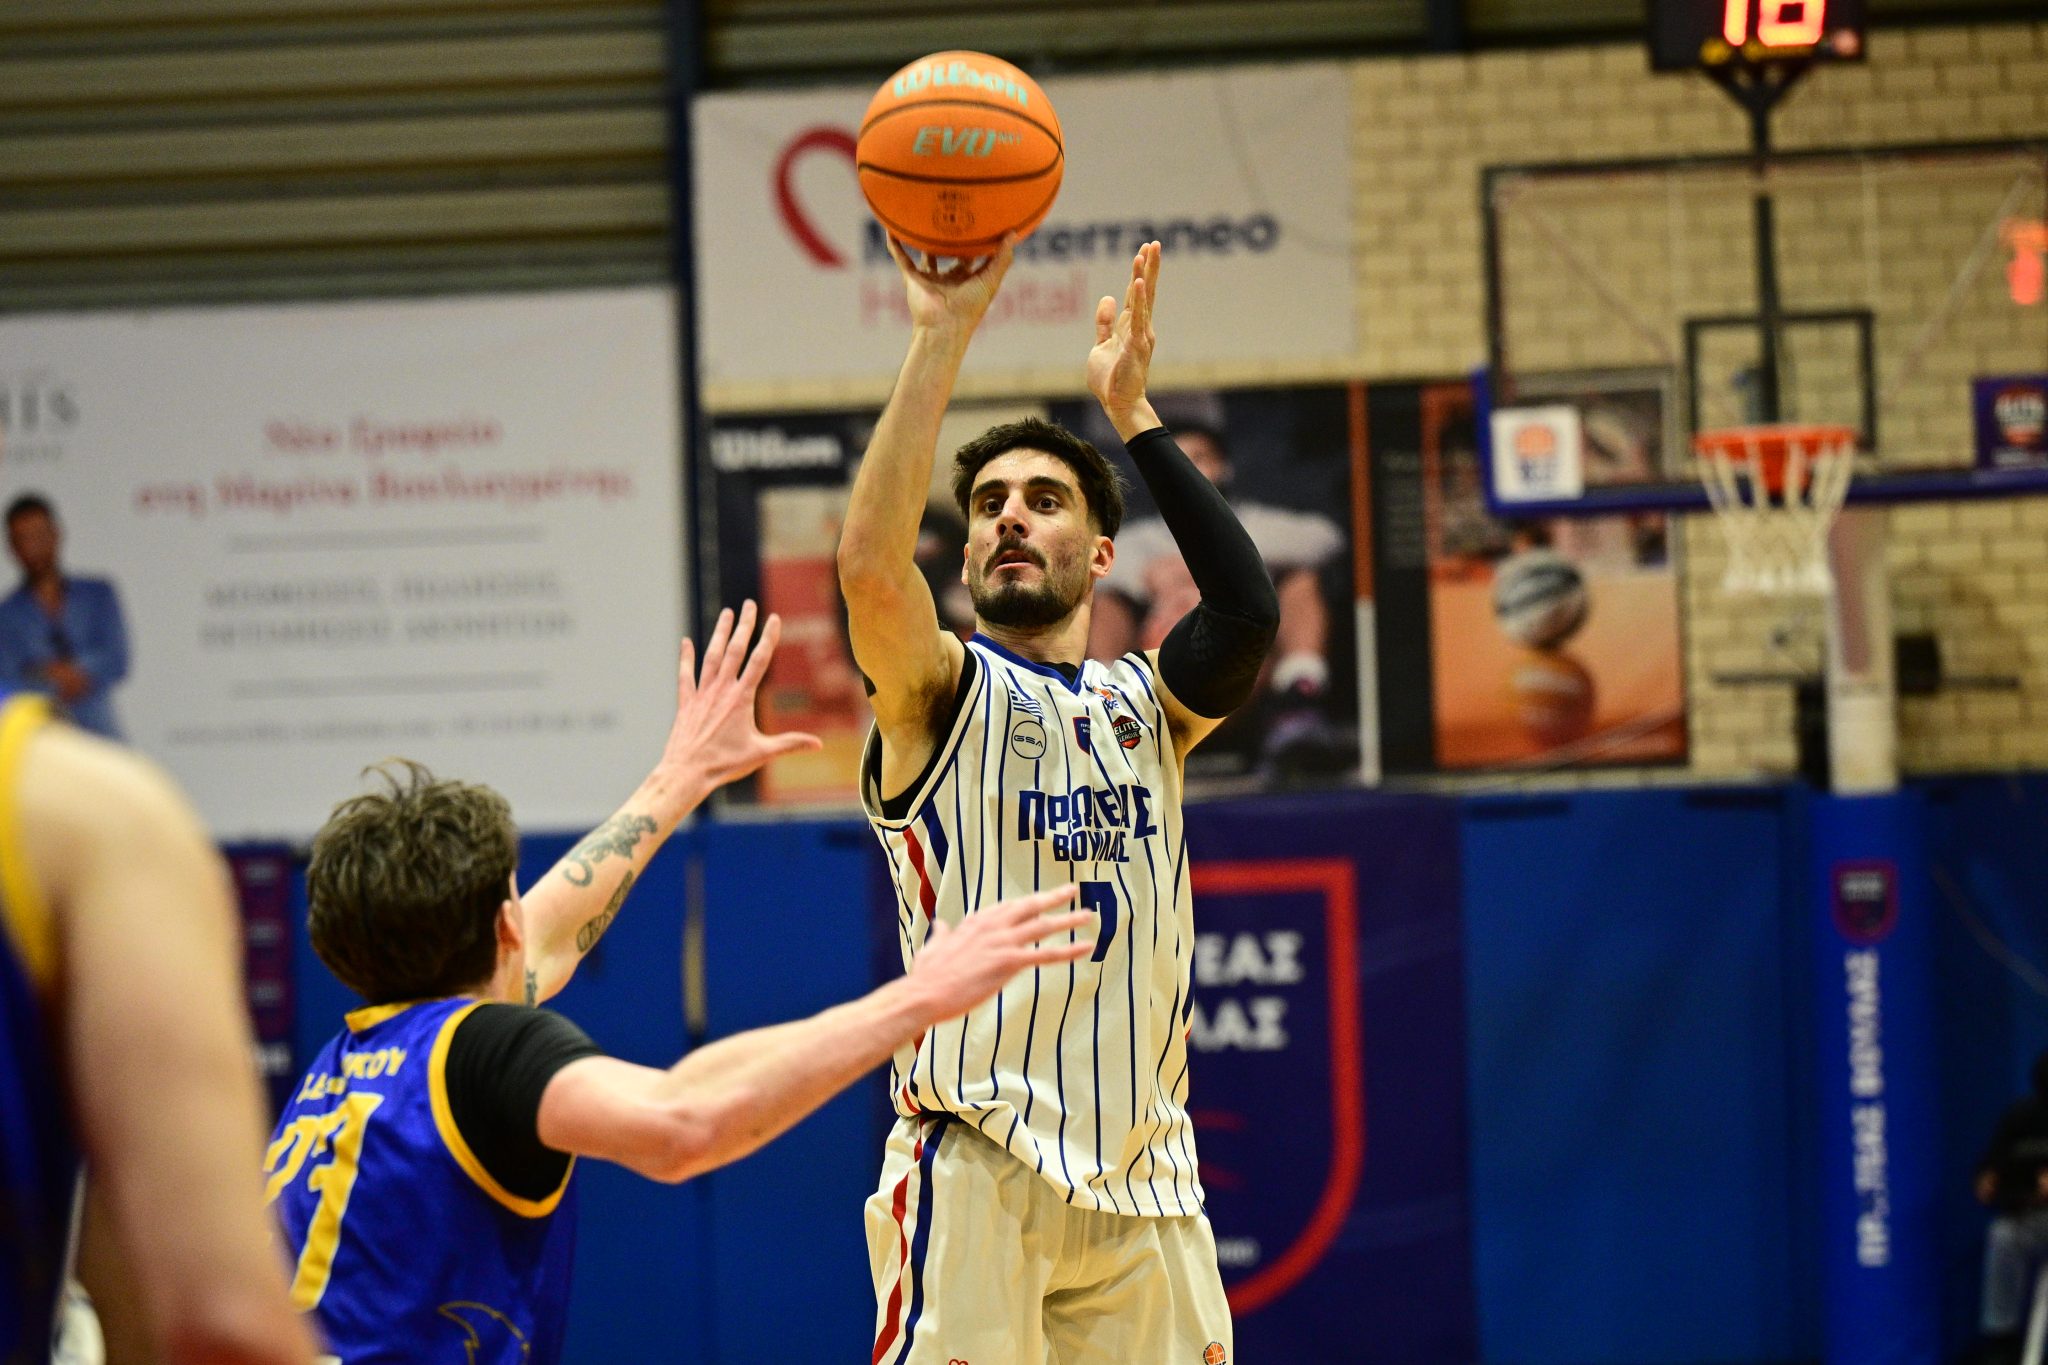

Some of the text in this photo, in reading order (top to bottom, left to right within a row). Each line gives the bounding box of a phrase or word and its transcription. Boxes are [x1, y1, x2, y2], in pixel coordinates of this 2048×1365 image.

[893, 61, 1028, 107] Wilson
[912, 126, 997, 158] EVO
[1013, 734, 1044, 749] GSA
[1113, 721, 1139, 735] ELITE
[1079, 881, 1118, 963] 7
[1195, 932, 1305, 986] ΕΑΣ
